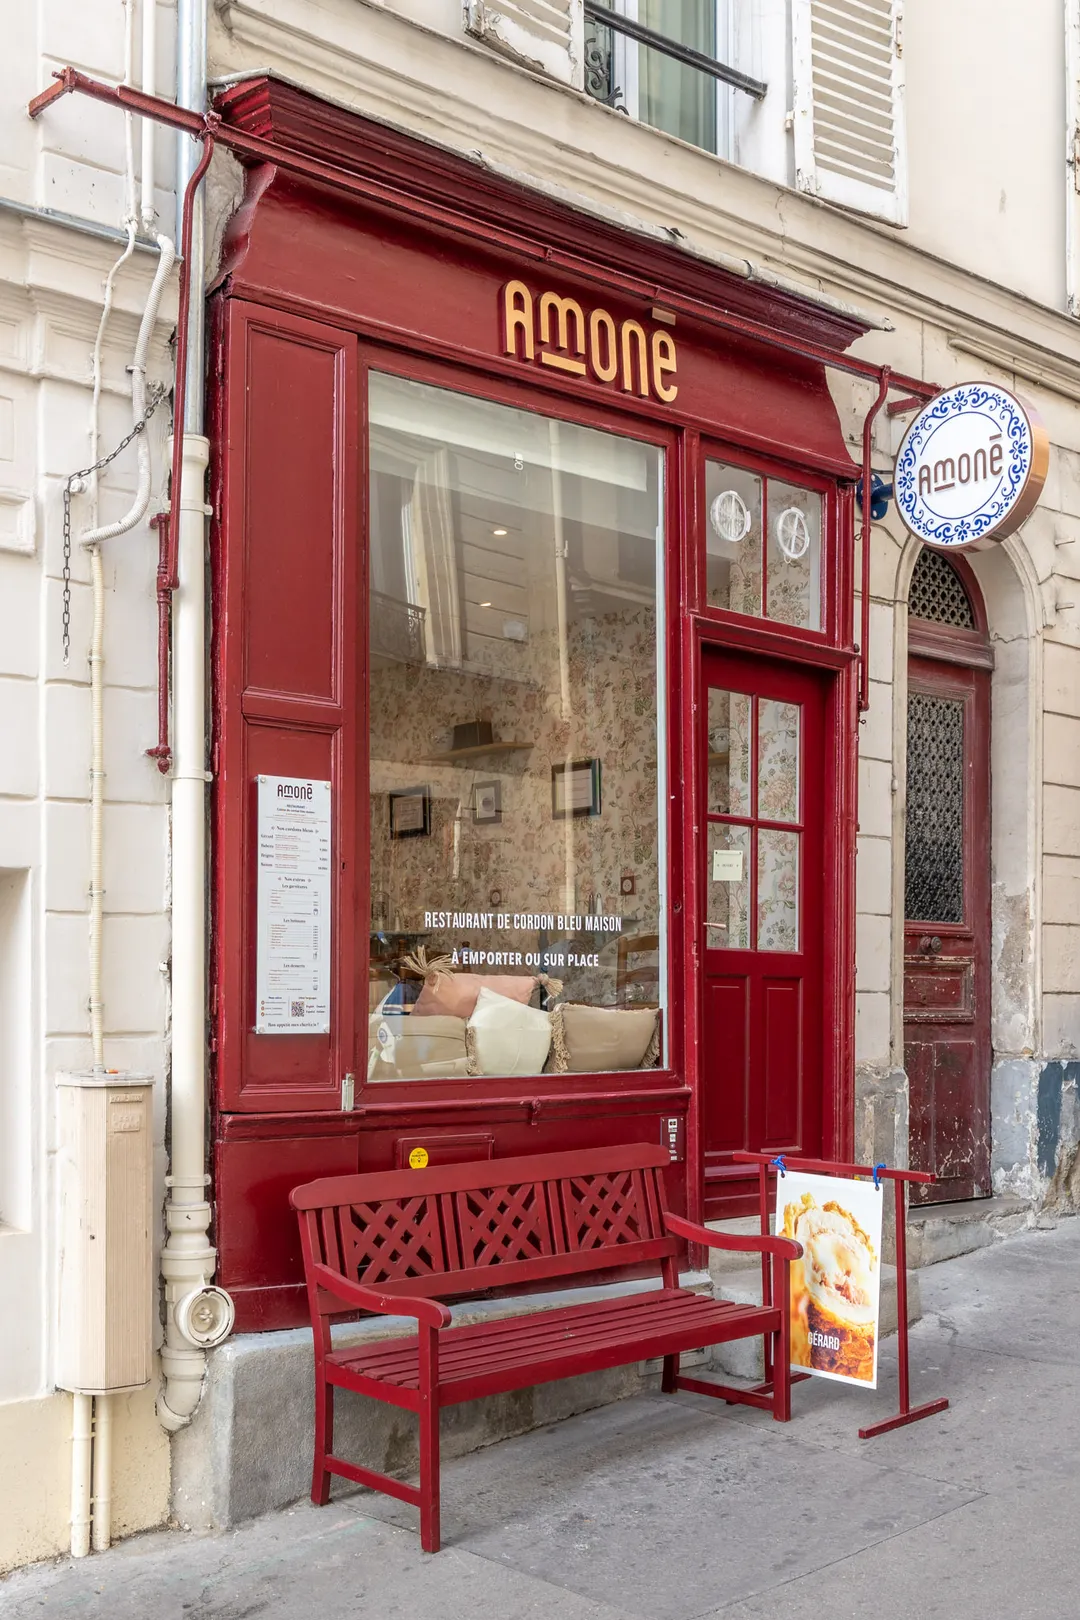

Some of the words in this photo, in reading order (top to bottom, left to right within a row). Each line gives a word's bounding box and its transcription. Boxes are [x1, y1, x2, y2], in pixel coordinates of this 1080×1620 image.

[424, 911, 494, 929] RESTAURANT
[497, 914, 511, 929] DE
[513, 914, 554, 930] CORDON
[557, 915, 582, 931] BLEU
[584, 916, 622, 932] MAISON
[451, 947, 459, 965] À
[462, 950, 522, 966] EMPORTER
[526, 952, 540, 966] OU
[543, 952, 565, 967] SUR
[567, 953, 599, 967] PLACE
[807, 1330, 841, 1352] GÉRARD
